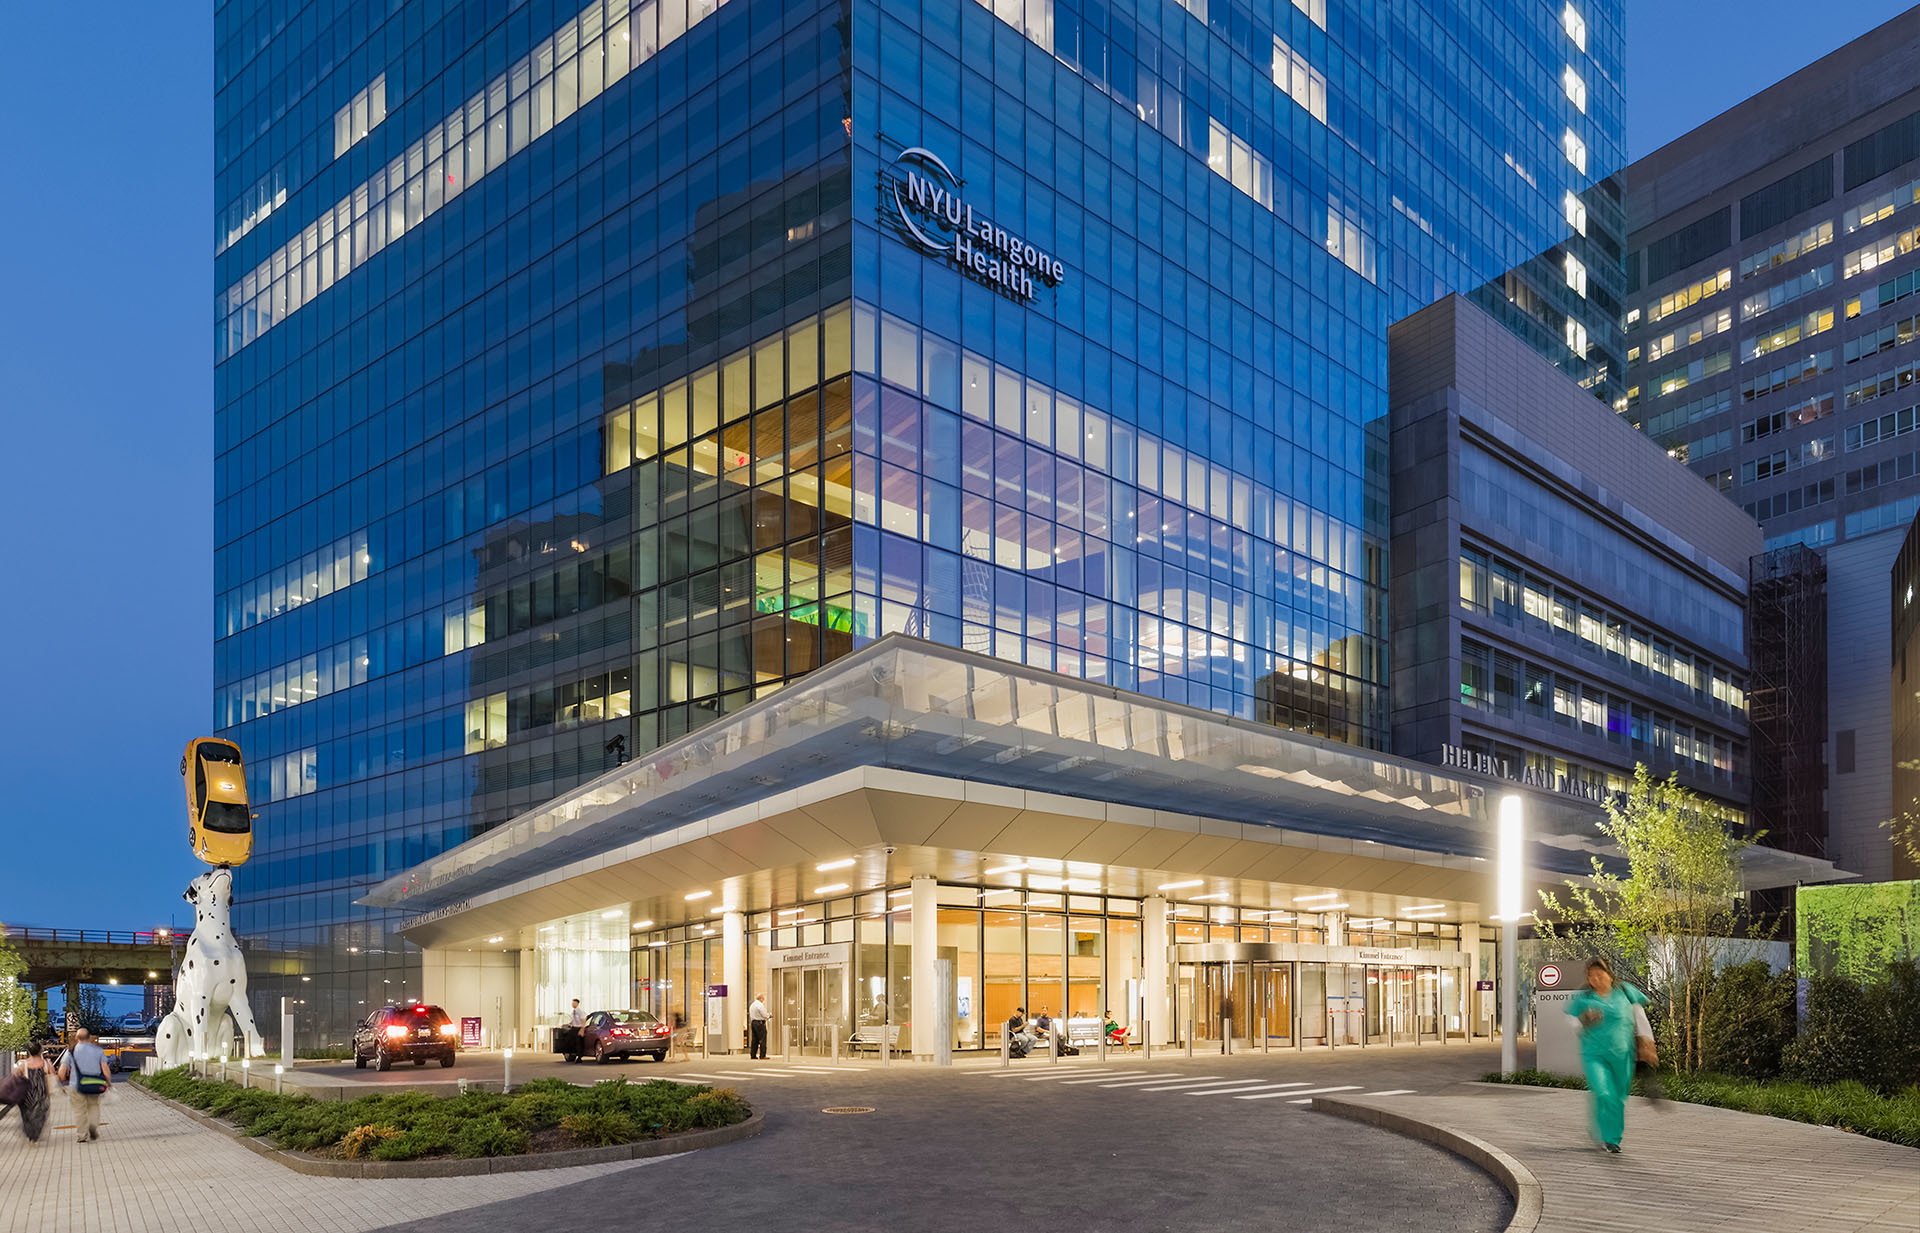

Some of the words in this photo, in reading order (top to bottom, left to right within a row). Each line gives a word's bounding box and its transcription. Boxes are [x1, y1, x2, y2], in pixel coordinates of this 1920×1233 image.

[955, 233, 1033, 298] Health
[966, 204, 1064, 281] Langone
[1441, 743, 1499, 777] HELEN
[1522, 765, 1556, 790] AND
[1558, 774, 1611, 803] MARTIN
[804, 951, 830, 960] Entrance
